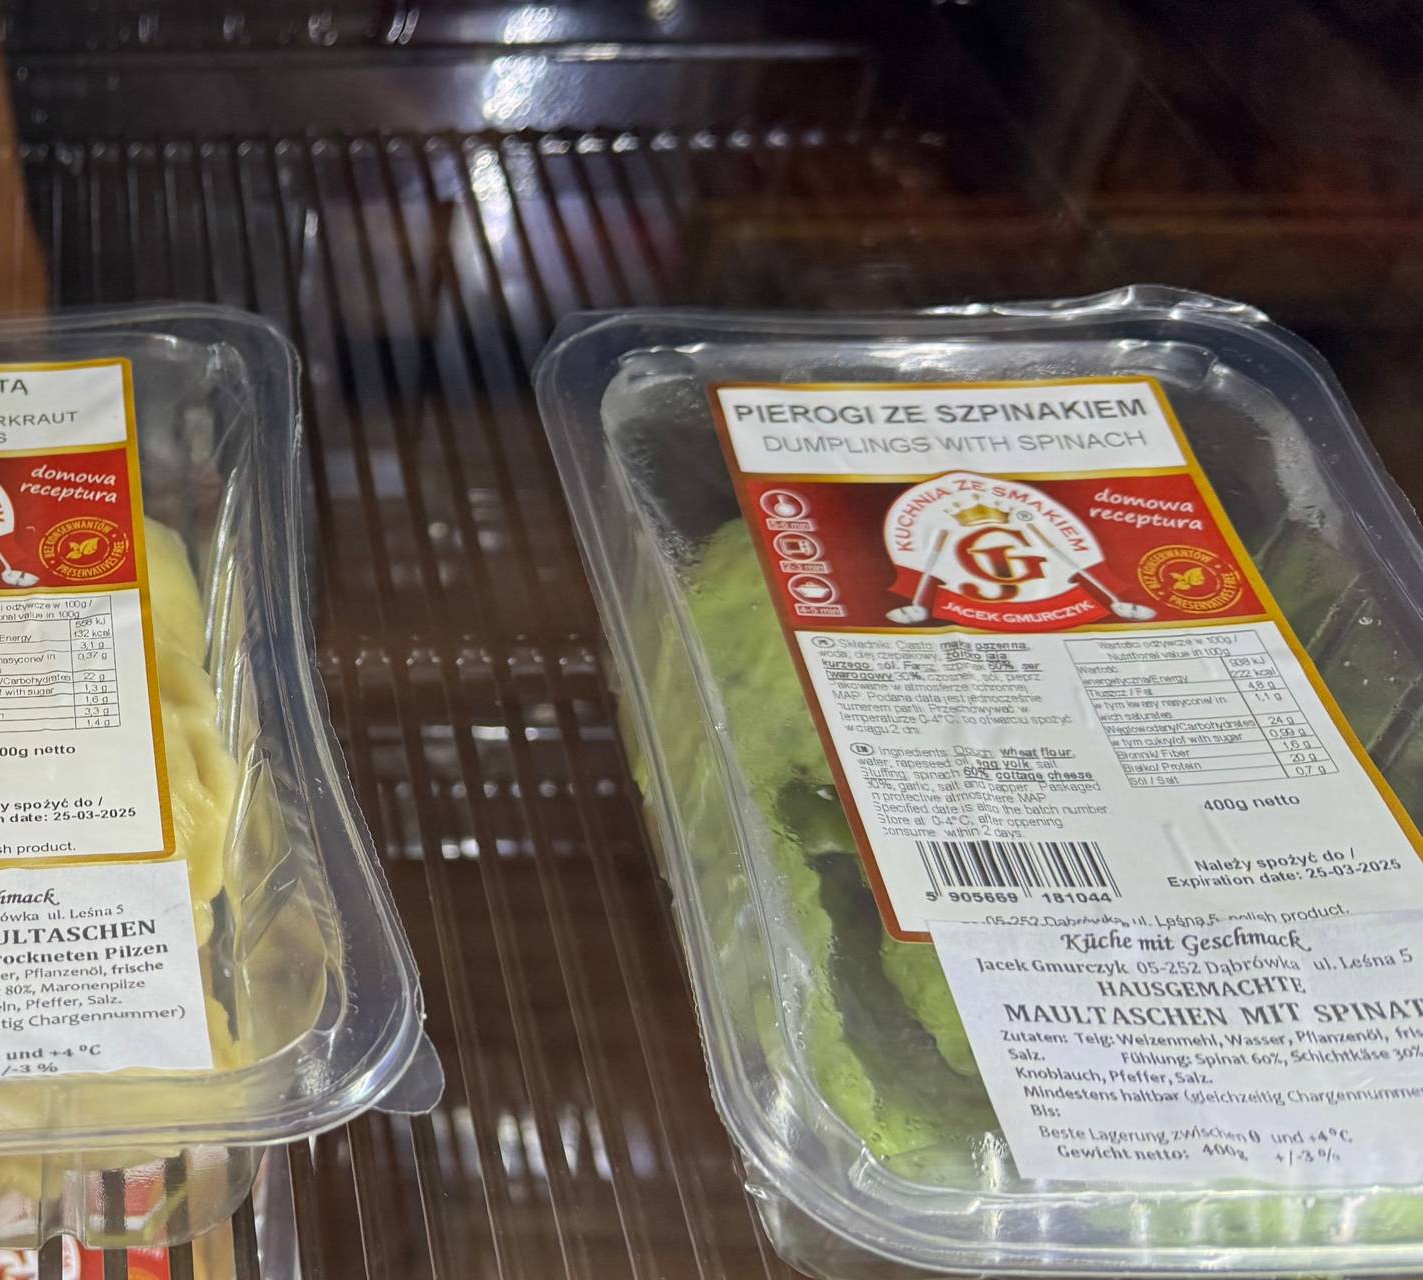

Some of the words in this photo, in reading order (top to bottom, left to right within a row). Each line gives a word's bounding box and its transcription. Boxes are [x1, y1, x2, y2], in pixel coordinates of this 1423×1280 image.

[735, 405, 873, 424] PIEROGI
[885, 404, 926, 423] ZE
[937, 398, 1147, 423] SZPINAKIEM
[764, 435, 930, 454] DUMPLINGS
[936, 435, 1011, 453] WITH
[1020, 430, 1147, 451] SPINACH
[32, 465, 116, 486] domowa
[20, 481, 116, 503] receptura
[1094, 488, 1194, 513] domowa
[897, 487, 949, 553] KUCHNIA
[956, 480, 986, 493] ZE
[990, 485, 1089, 553] SMAKIEM
[1089, 504, 1204, 531] receptura
[943, 602, 1000, 622] JACEK
[1004, 600, 1096, 624] GMURCZYK
[34, 743, 76, 756] netto
[15, 798, 69, 814] spożyć
[74, 798, 93, 809] do
[1204, 798, 1249, 813] 400g
[1253, 794, 1300, 808] netto
[10, 812, 49, 825] date:
[53, 807, 136, 822] 25-03-2025
[17, 841, 76, 856] product.
[1195, 858, 1252, 872] Należy
[1256, 852, 1318, 870] spożyć
[1323, 851, 1344, 863] do
[1167, 874, 1256, 890] Expiration
[1260, 870, 1303, 884] date:
[1307, 858, 1402, 878] 25-03-2025
[48, 909, 65, 920] ul.
[70, 907, 111, 919] Leśna
[116, 904, 124, 915] 5
[105, 943, 168, 960] Pilzen
[1060, 929, 1132, 953] Küche
[1138, 933, 1175, 950] mit
[1181, 929, 1312, 955] Geschmack
[25, 965, 107, 979] Pflanzenöl,
[111, 961, 164, 974] frische
[1031, 960, 1129, 977] Gmurczyk
[6, 984, 36, 996] 80%,
[41, 979, 145, 993] Maronenpilze
[1097, 976, 1306, 998] HAUSGEMACHTE
[26, 997, 83, 1010] Pfeffer,
[88, 995, 122, 1005] Salz.
[28, 1005, 186, 1027] Chargennummer)
[1004, 1003, 1228, 1026] MAULTASCHEN
[1242, 1003, 1301, 1024] MIT
[1000, 1030, 1068, 1044] Zutaten:
[1074, 1032, 1115, 1048] Teig:
[1116, 1032, 1222, 1049] Weizenmehl,
[1225, 1033, 1292, 1049] Wasser,
[1016, 1066, 1106, 1084] Knoblauch,
[1109, 1068, 1173, 1085] Pfeffer,
[1175, 1070, 1214, 1084] Salz.
